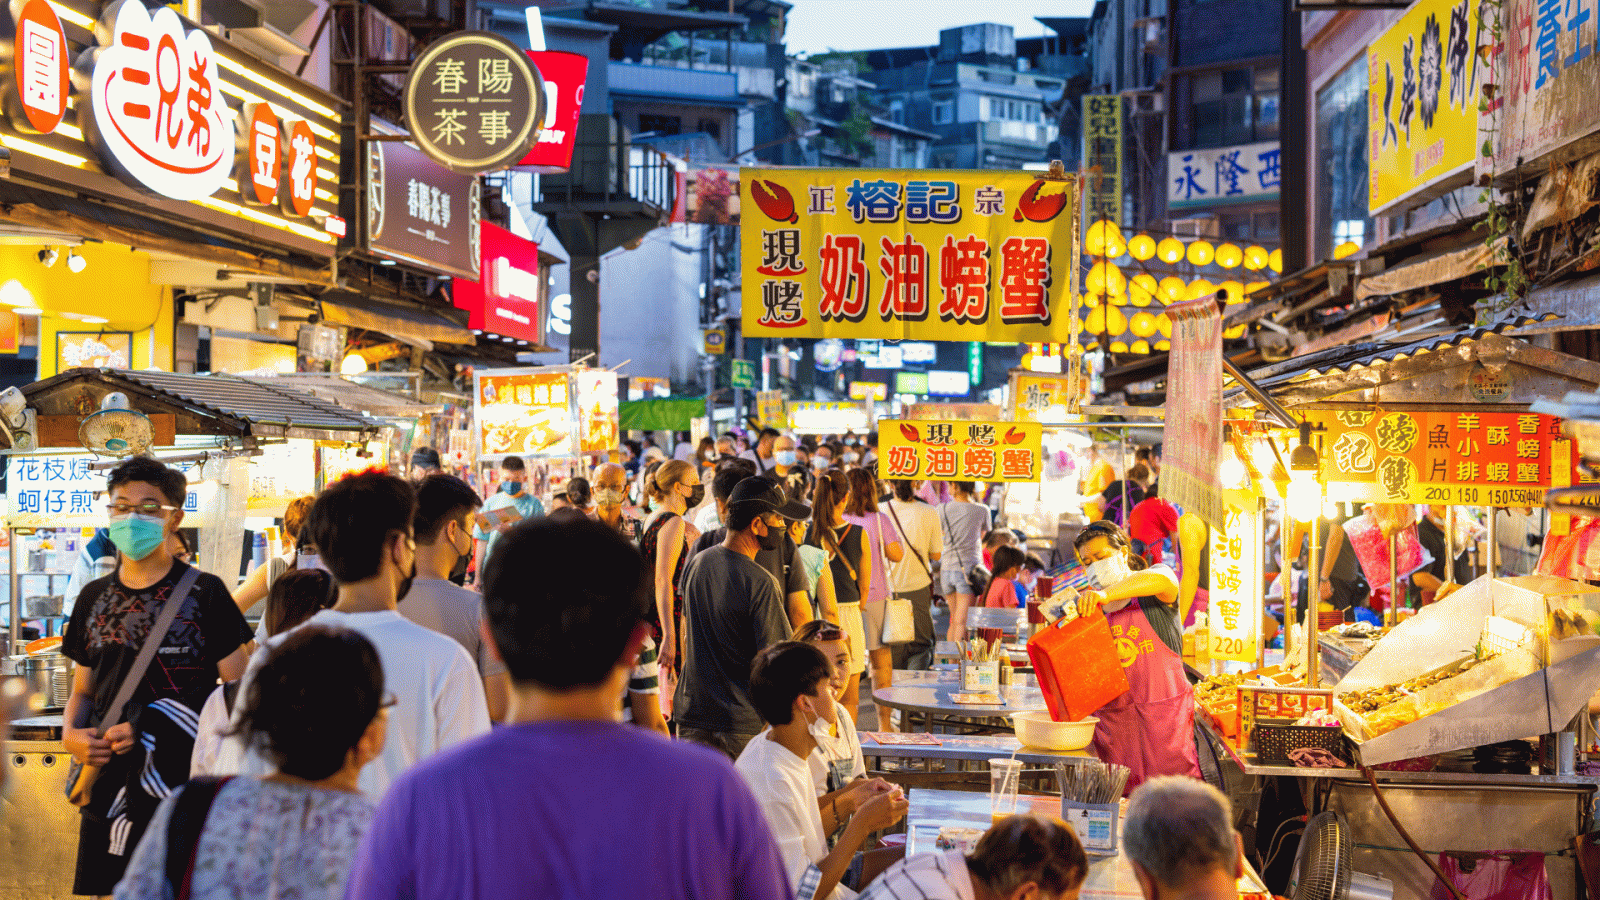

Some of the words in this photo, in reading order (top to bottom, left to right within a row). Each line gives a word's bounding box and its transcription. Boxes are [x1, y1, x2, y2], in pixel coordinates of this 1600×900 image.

[120, 31, 213, 158] 三兄弟
[432, 58, 514, 95] 春陽
[432, 108, 513, 146] 茶事
[253, 118, 314, 202] 豆花
[809, 186, 836, 215] 正
[846, 179, 961, 224] 榕記
[975, 187, 1005, 215] 宗
[762, 229, 804, 323] 現烤
[819, 234, 1054, 326] 奶油螃蟹
[926, 423, 996, 446] 現烤
[1376, 412, 1418, 500] 螃蟹
[1428, 424, 1450, 482] 魚片
[1457, 413, 1480, 482] 羊小排
[1486, 426, 1510, 483] 酥蝦
[1516, 414, 1540, 483] 香螃蟹
[887, 446, 1034, 479] 奶油螃蟹
[18, 489, 93, 513] 蚵仔煎
[1425, 487, 1450, 501] 200
[1457, 487, 1479, 503] 150
[1487, 489, 1508, 505] 150
[1214, 637, 1243, 655] 220
